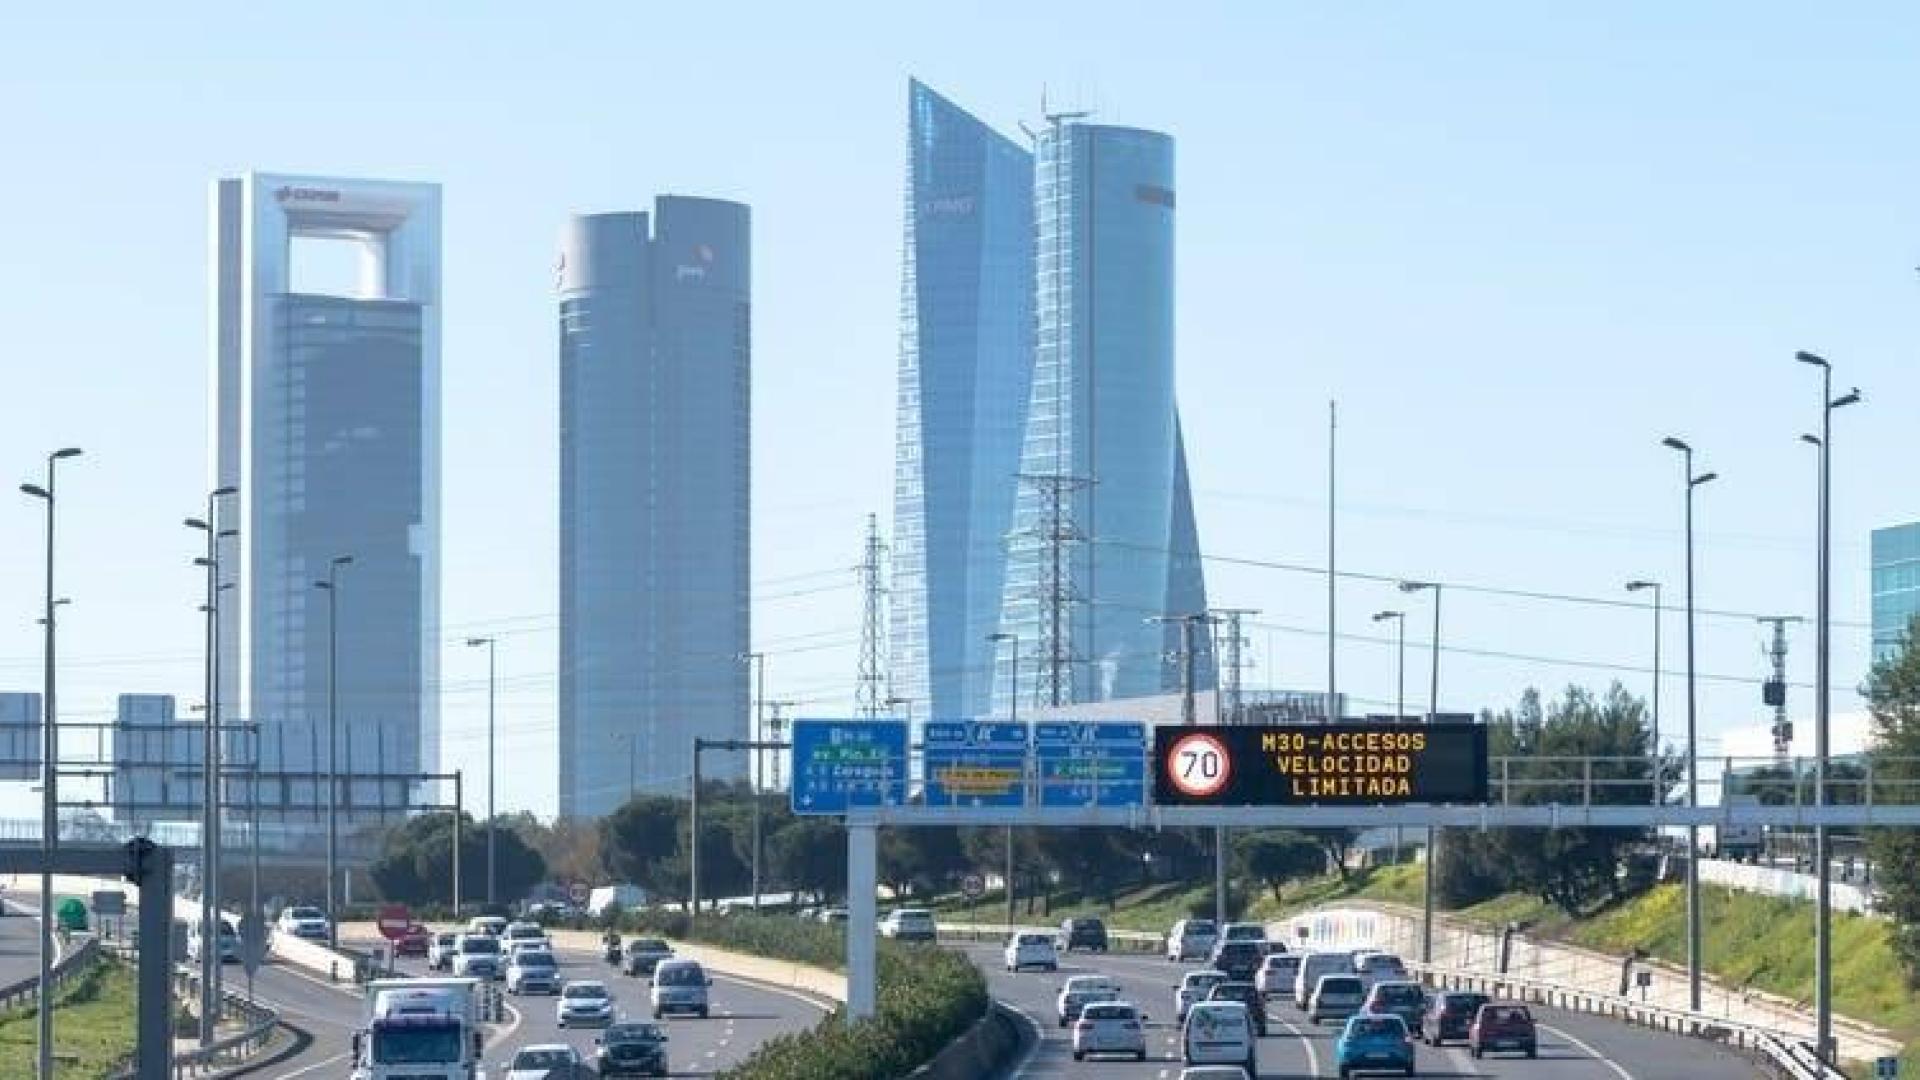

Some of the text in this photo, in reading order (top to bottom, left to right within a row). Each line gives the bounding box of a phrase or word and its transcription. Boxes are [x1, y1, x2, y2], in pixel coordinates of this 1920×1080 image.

[1262, 733, 1426, 751] M30-ACCESOS
[1181, 751, 1218, 778] 70
[1277, 755, 1411, 773] VELOCIDAD
[1294, 777, 1412, 796] LIMITADA
